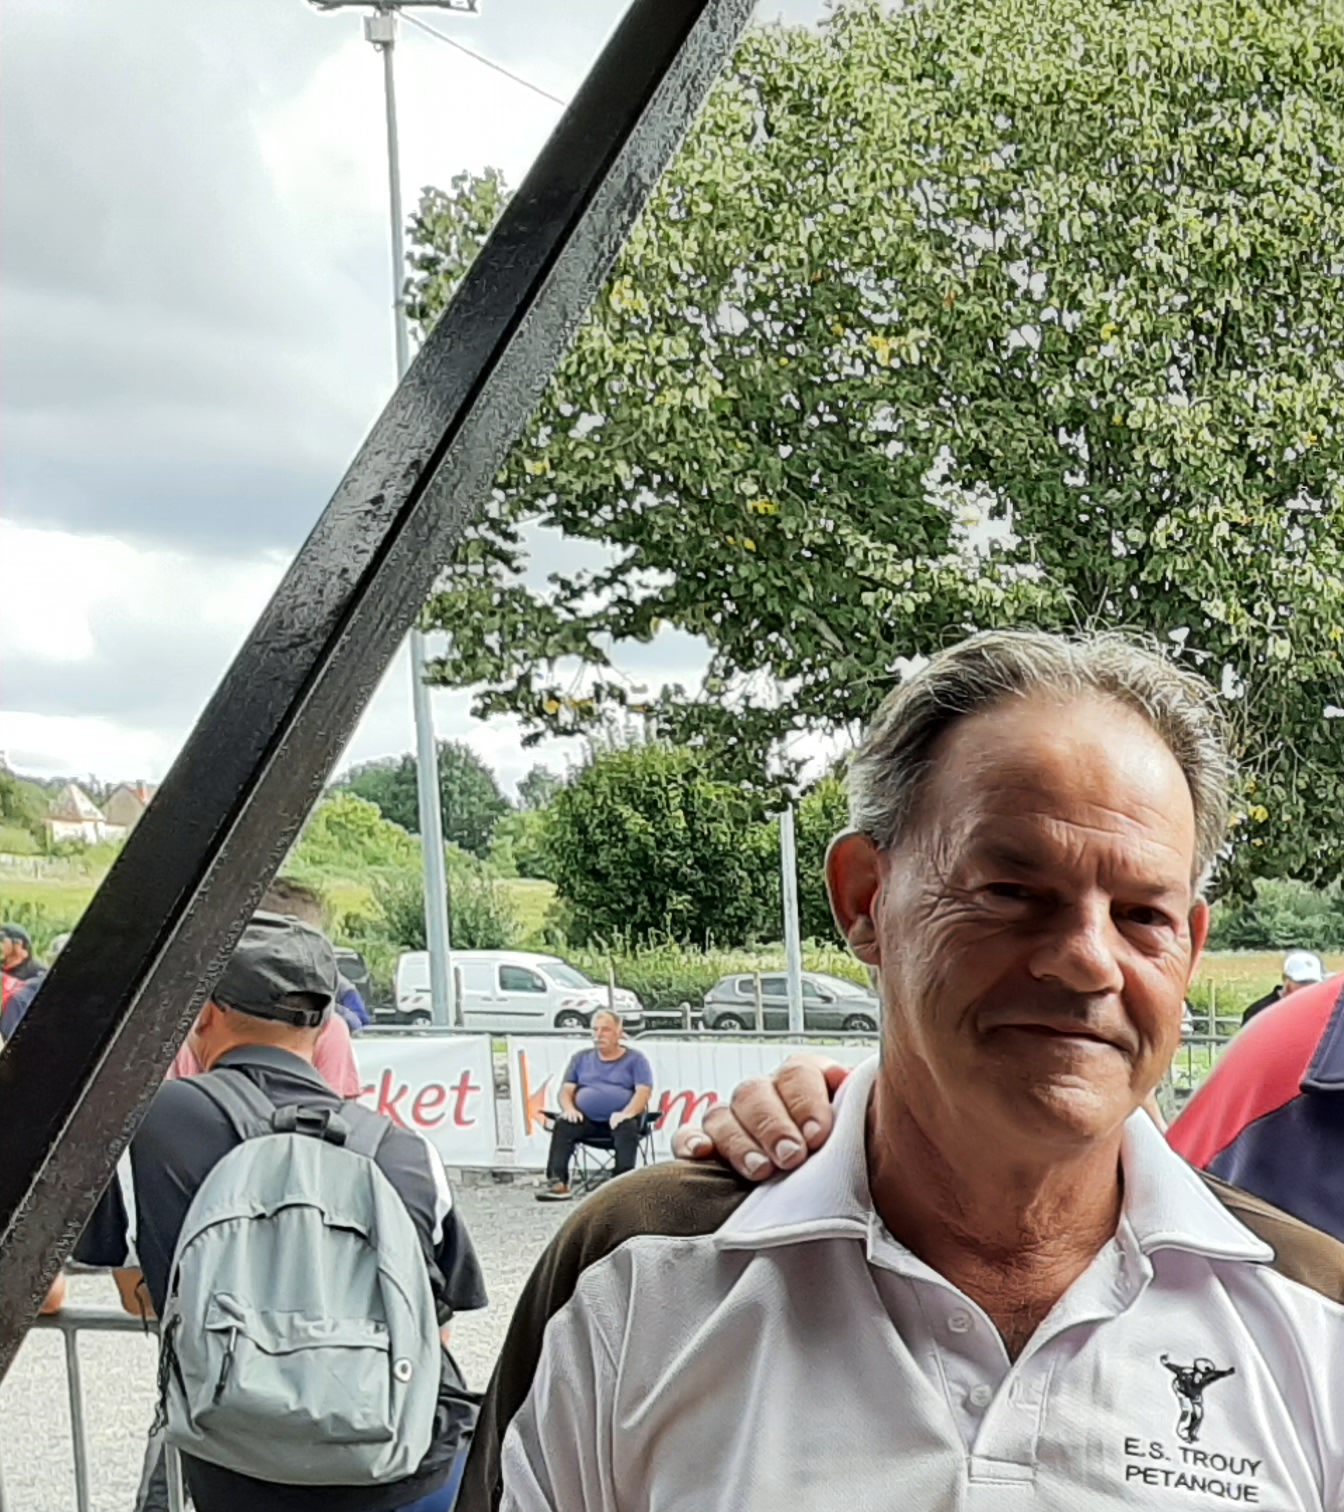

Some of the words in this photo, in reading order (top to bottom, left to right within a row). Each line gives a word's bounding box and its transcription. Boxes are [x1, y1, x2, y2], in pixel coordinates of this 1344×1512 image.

[1124, 1437, 1171, 1461] E.S.
[1178, 1446, 1262, 1477] TROUY
[1124, 1464, 1260, 1503] PETANQUE
